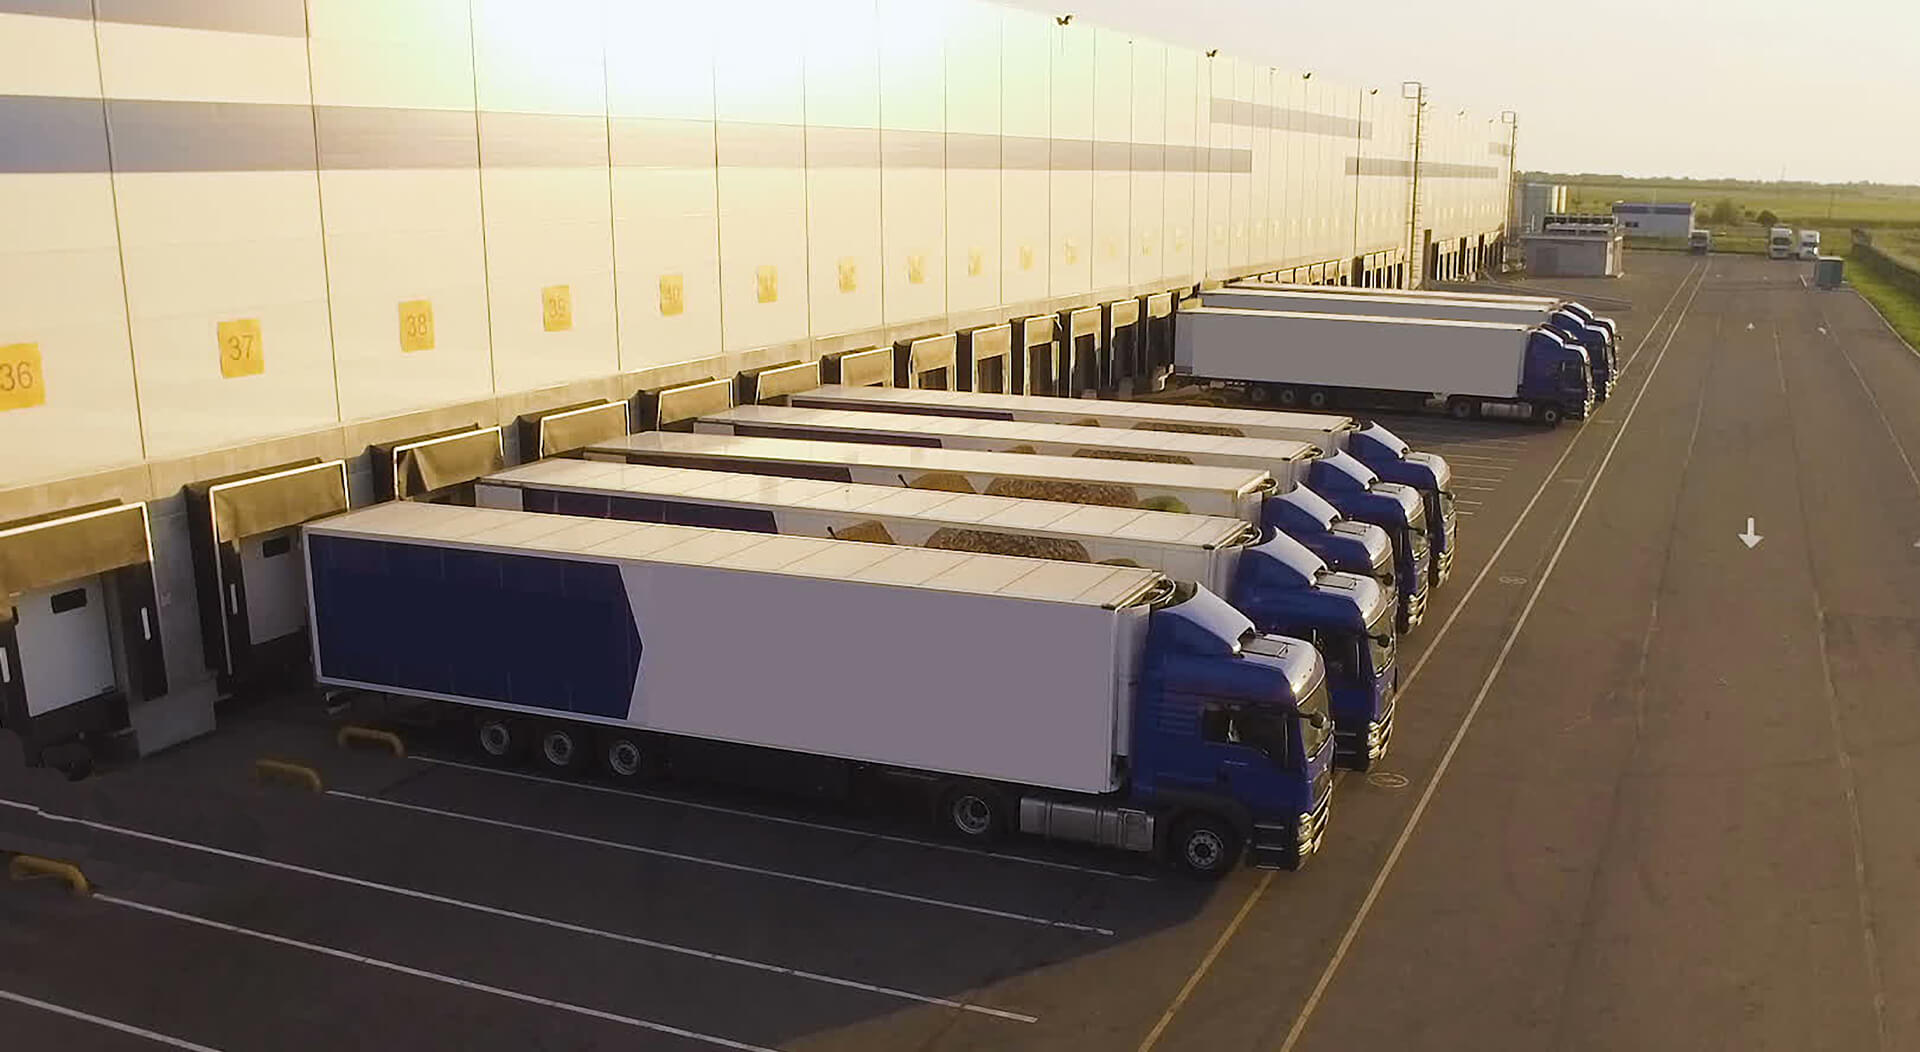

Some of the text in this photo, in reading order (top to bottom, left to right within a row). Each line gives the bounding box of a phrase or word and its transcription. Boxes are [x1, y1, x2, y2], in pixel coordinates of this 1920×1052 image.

[406, 314, 428, 337] 38
[228, 335, 254, 361] 37
[0, 361, 33, 391] 36
